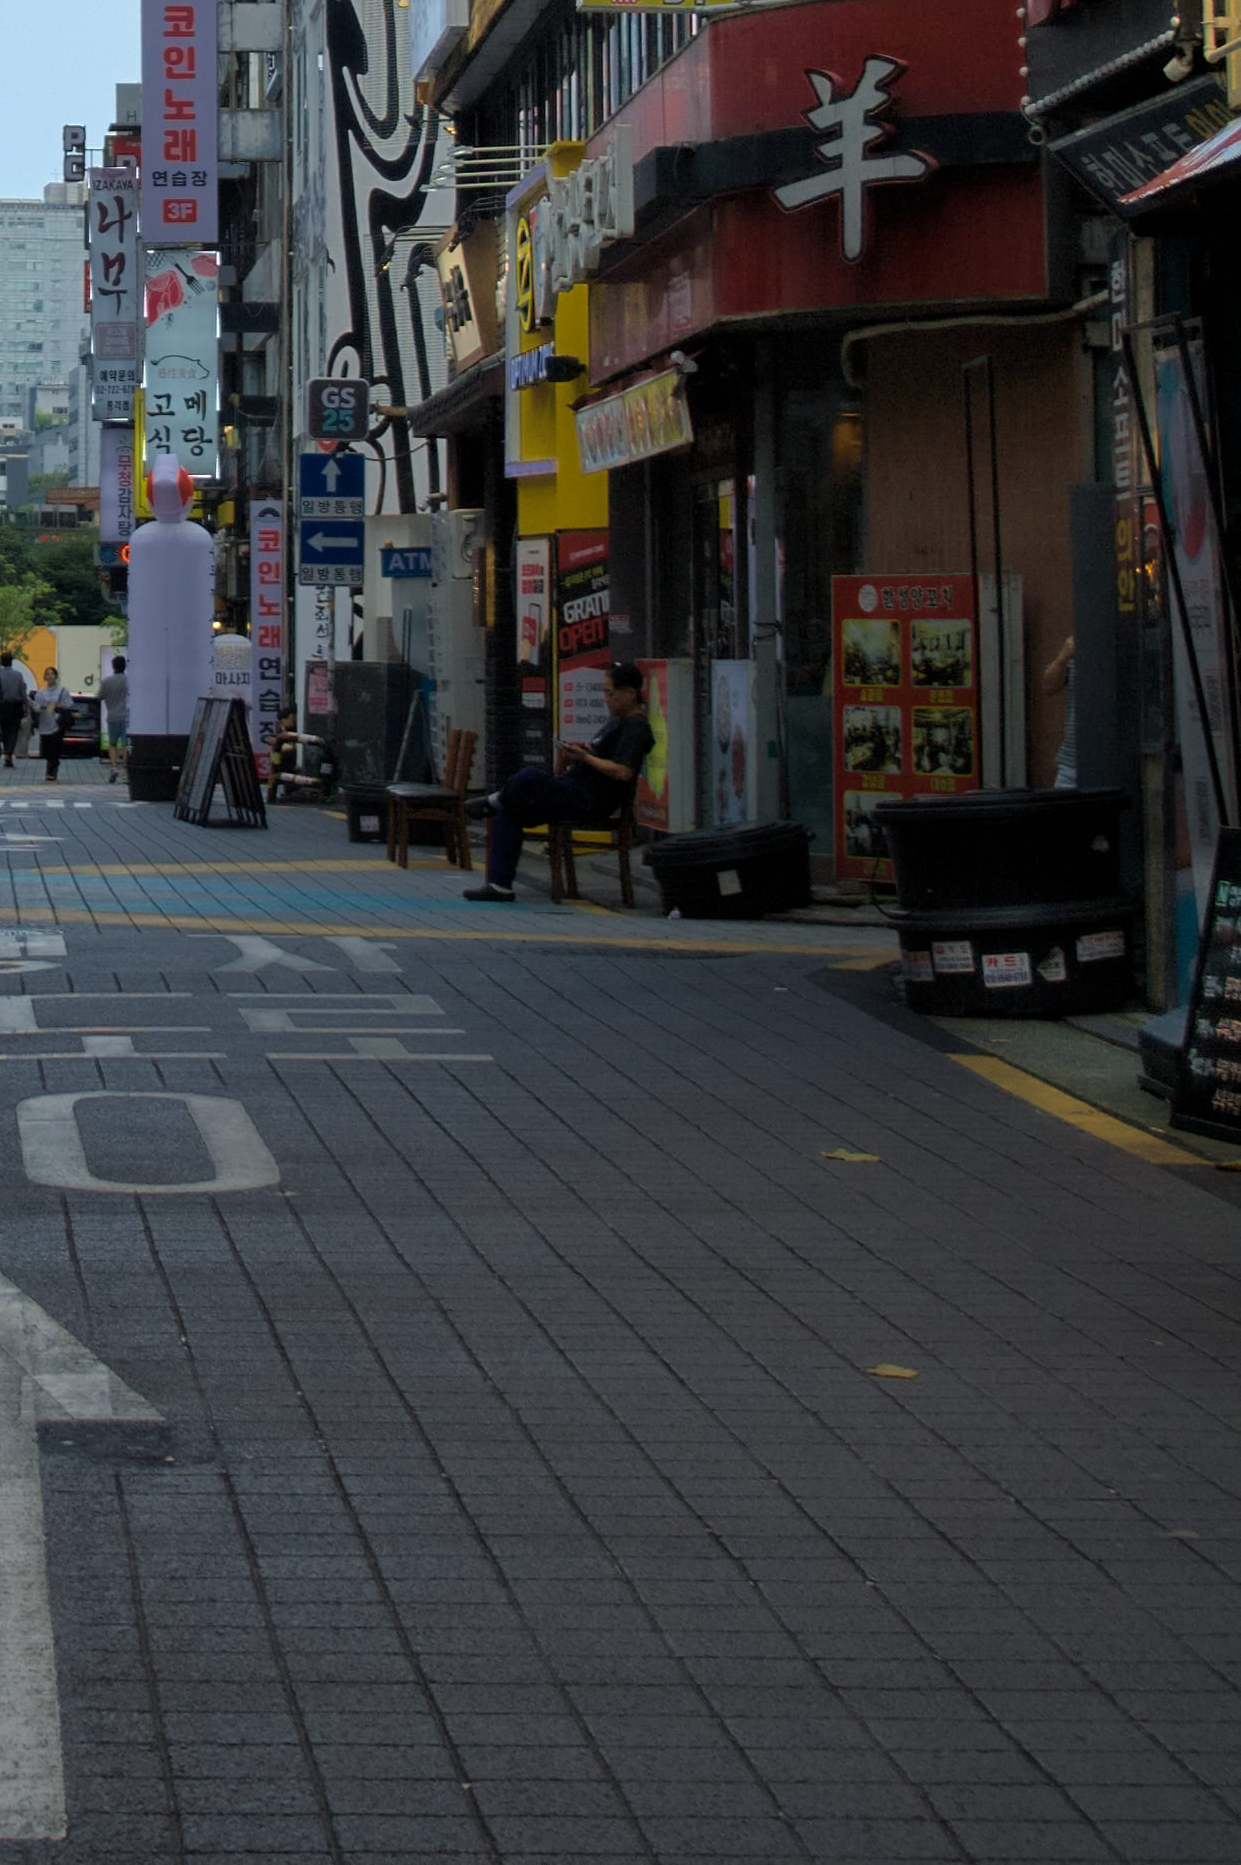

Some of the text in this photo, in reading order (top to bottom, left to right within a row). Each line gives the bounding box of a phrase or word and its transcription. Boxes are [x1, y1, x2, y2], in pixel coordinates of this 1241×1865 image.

[162, 4, 197, 164] 코인노래
[771, 53, 938, 262] 羊
[92, 179, 135, 191] IZAKAYA
[151, 170, 208, 189] 연습장
[166, 203, 194, 219] 3F
[320, 386, 357, 408] GS
[322, 409, 357, 433] 25
[117, 454, 133, 538] 무청감자탕
[301, 500, 363, 515] 일방통행
[387, 552, 432, 572] ATM
[301, 566, 363, 582] 일방통행
[257, 526, 283, 650] 코인노래
[214, 670, 251, 688] 마사지
